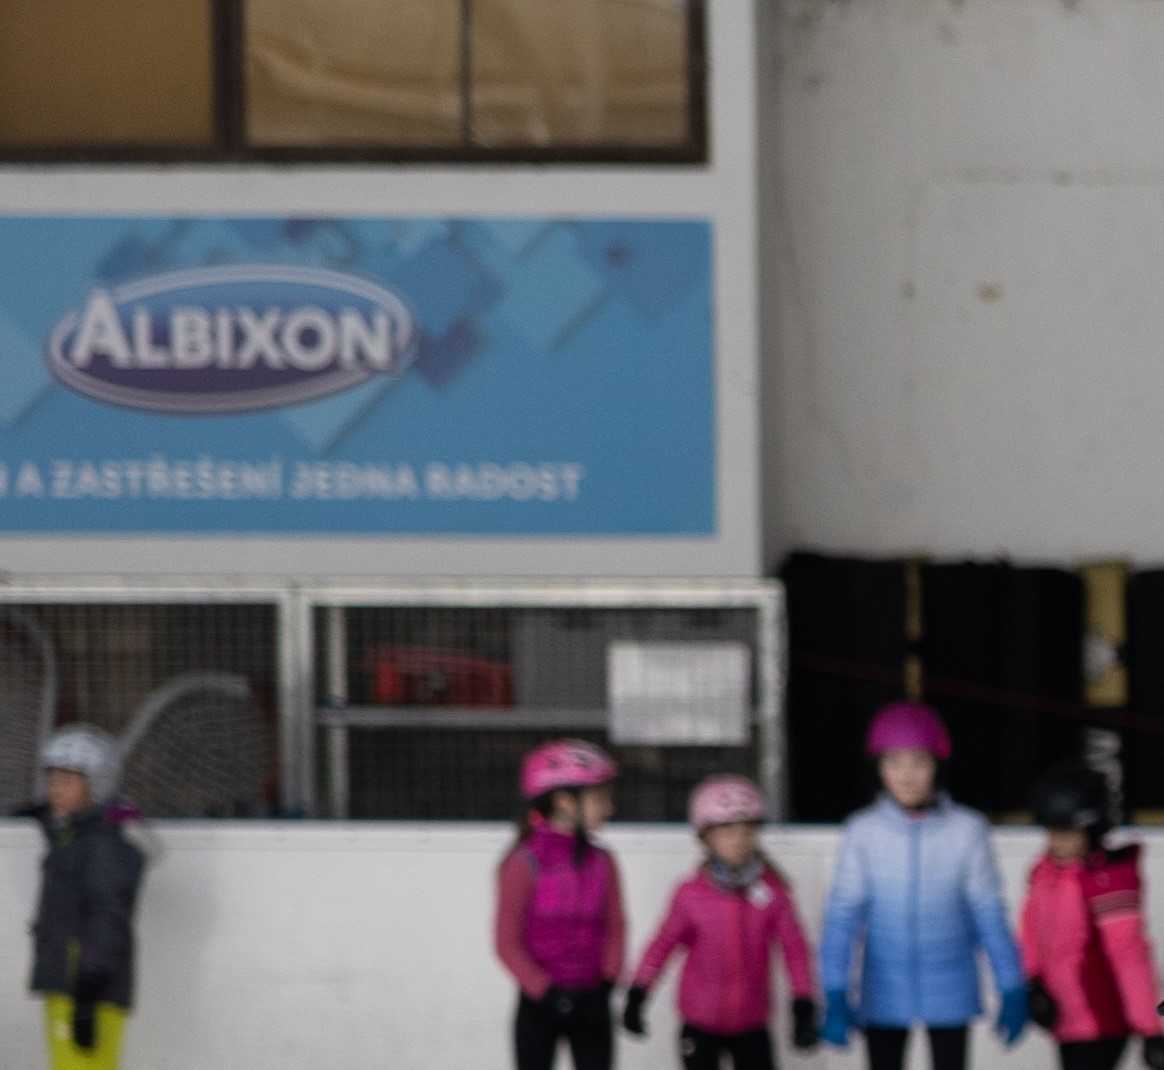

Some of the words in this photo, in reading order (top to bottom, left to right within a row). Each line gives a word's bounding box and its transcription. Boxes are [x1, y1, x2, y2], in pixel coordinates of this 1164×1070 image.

[71, 288, 393, 370] ALBIXON
[16, 461, 45, 498] A
[290, 460, 420, 500] JEDNA
[424, 461, 583, 500] RADOST
